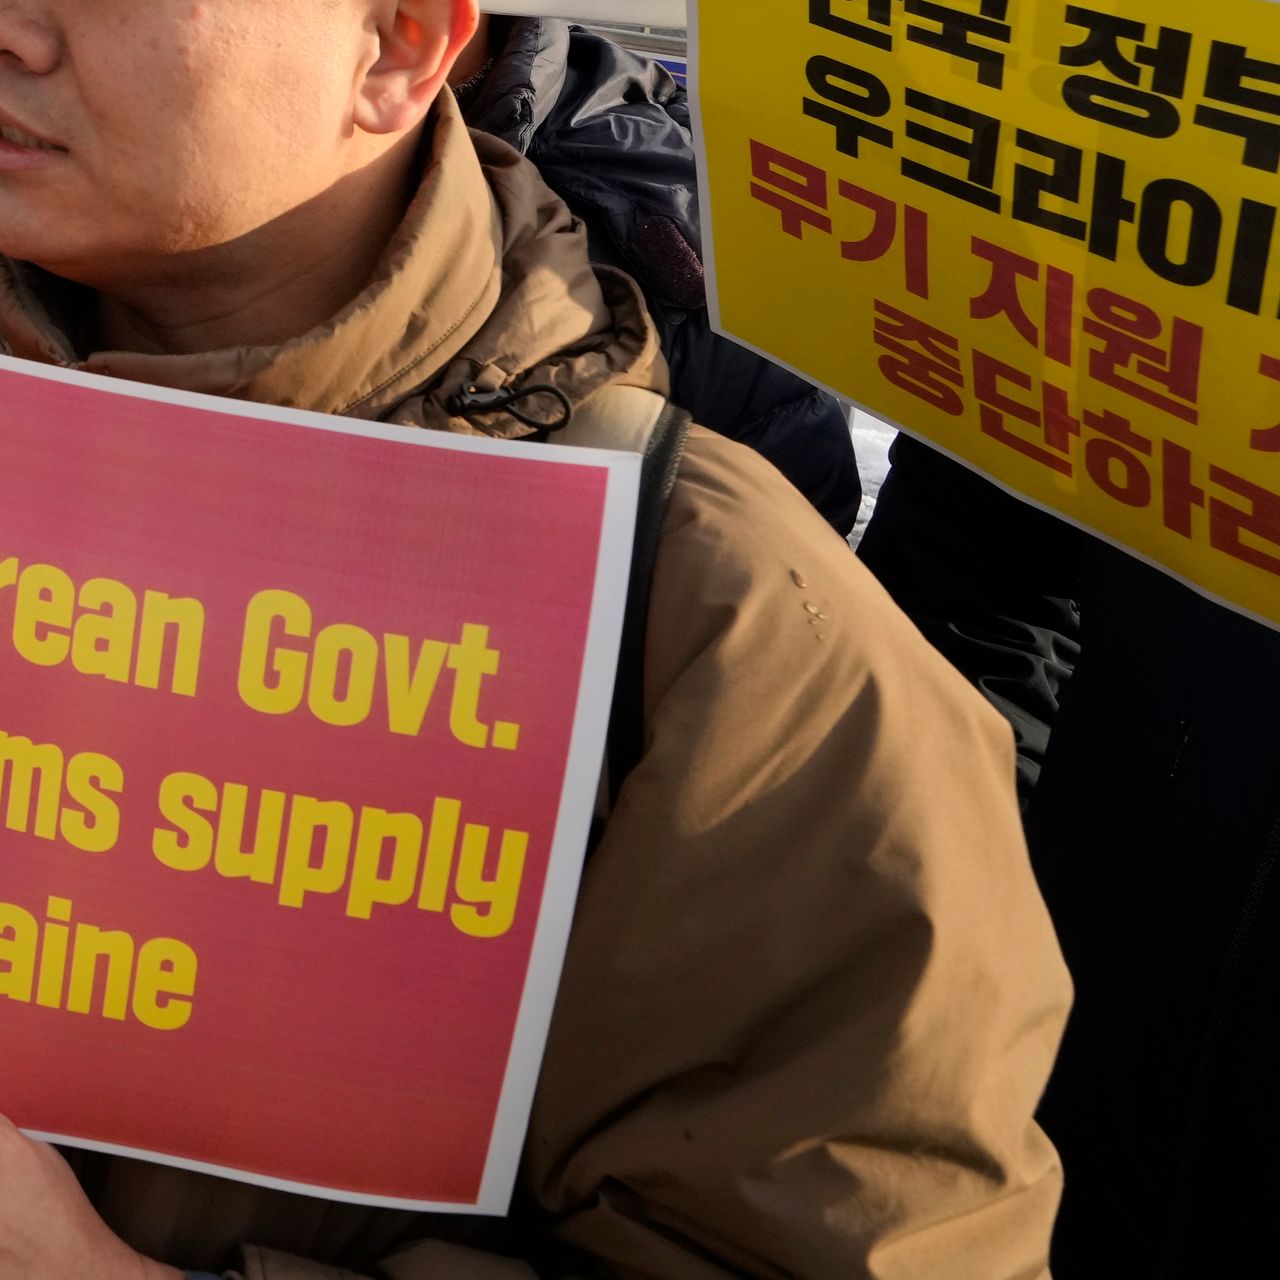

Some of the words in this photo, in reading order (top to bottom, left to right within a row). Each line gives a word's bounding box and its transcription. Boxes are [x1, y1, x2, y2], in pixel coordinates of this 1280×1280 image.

[749, 138, 929, 301] 무기
[969, 234, 1205, 427] 지원
[802, 54, 1280, 320] 우크라이
[236, 588, 521, 751] Govt.
[152, 769, 530, 939] supply
